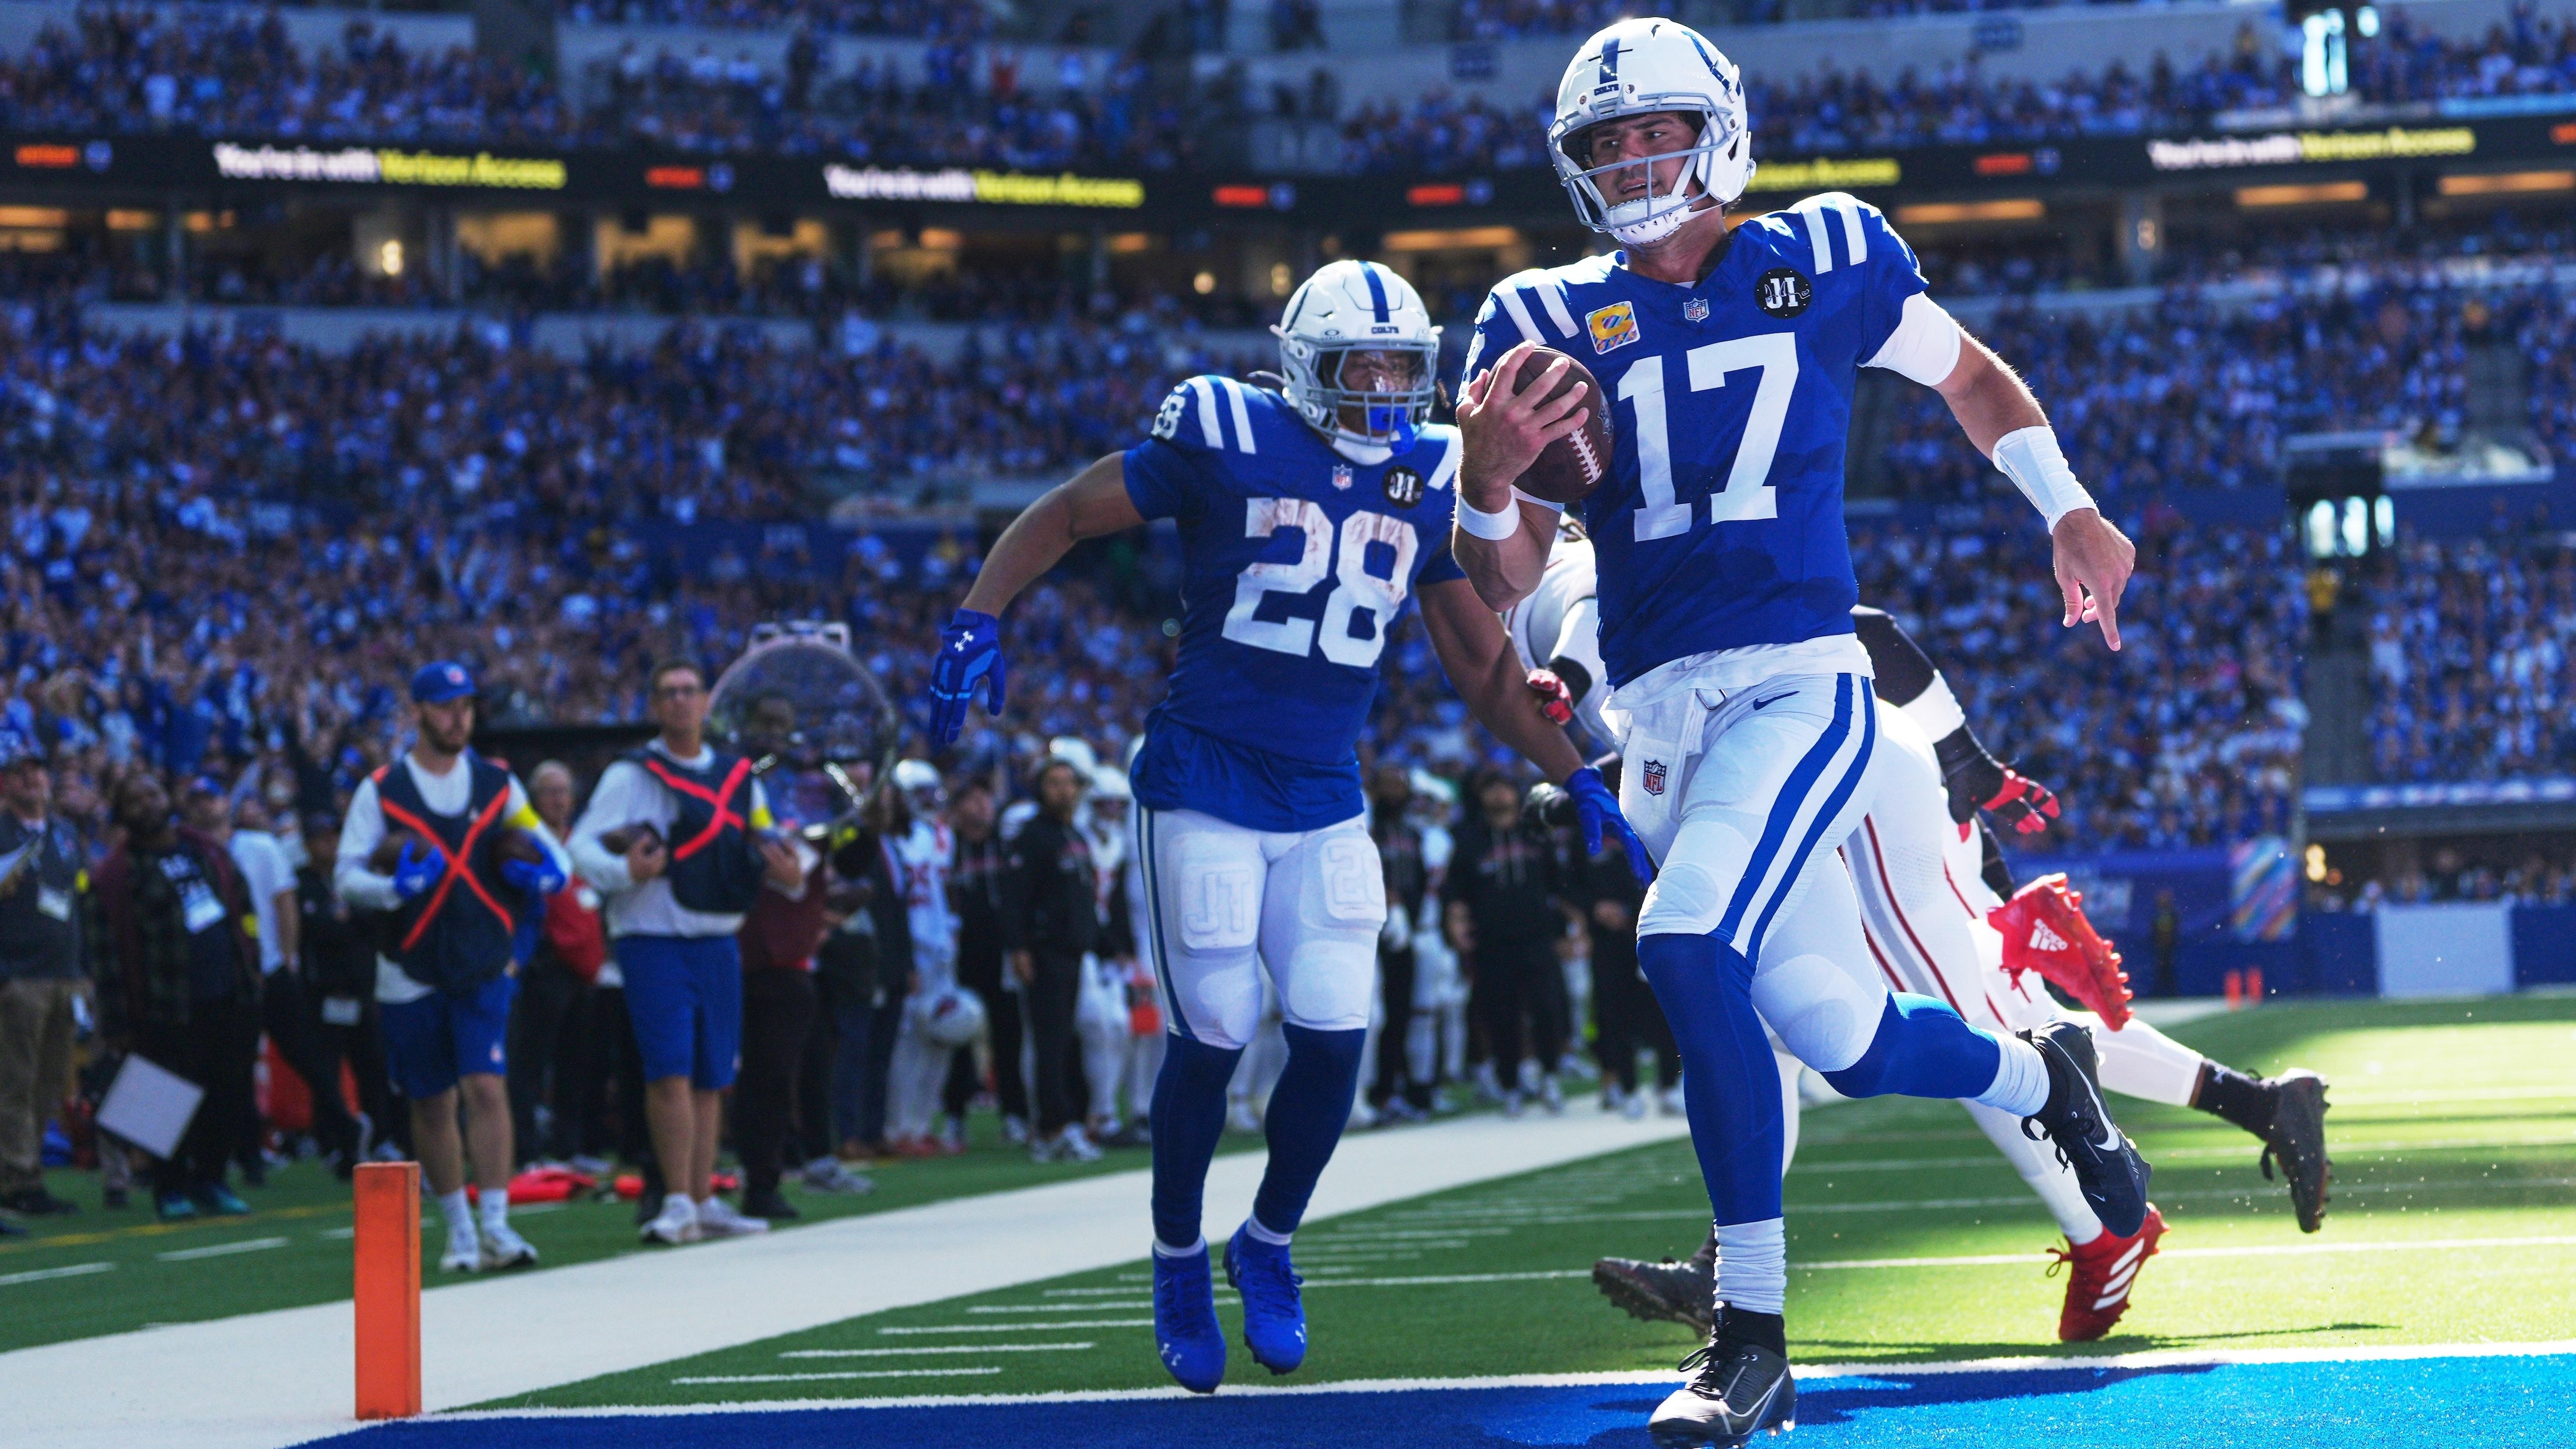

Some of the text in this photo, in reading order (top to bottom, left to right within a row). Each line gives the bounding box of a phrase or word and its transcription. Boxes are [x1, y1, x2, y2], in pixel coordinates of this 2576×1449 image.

[1594, 83, 1619, 96] COLTS
[1591, 305, 1634, 341] C
[1688, 307, 1705, 317] NFL
[1371, 326, 1399, 334] COLTS
[1618, 332, 1800, 543] 17
[1222, 497, 1418, 668] 28
[1645, 773, 1662, 791] NFL
[1184, 869, 1252, 935] JT
